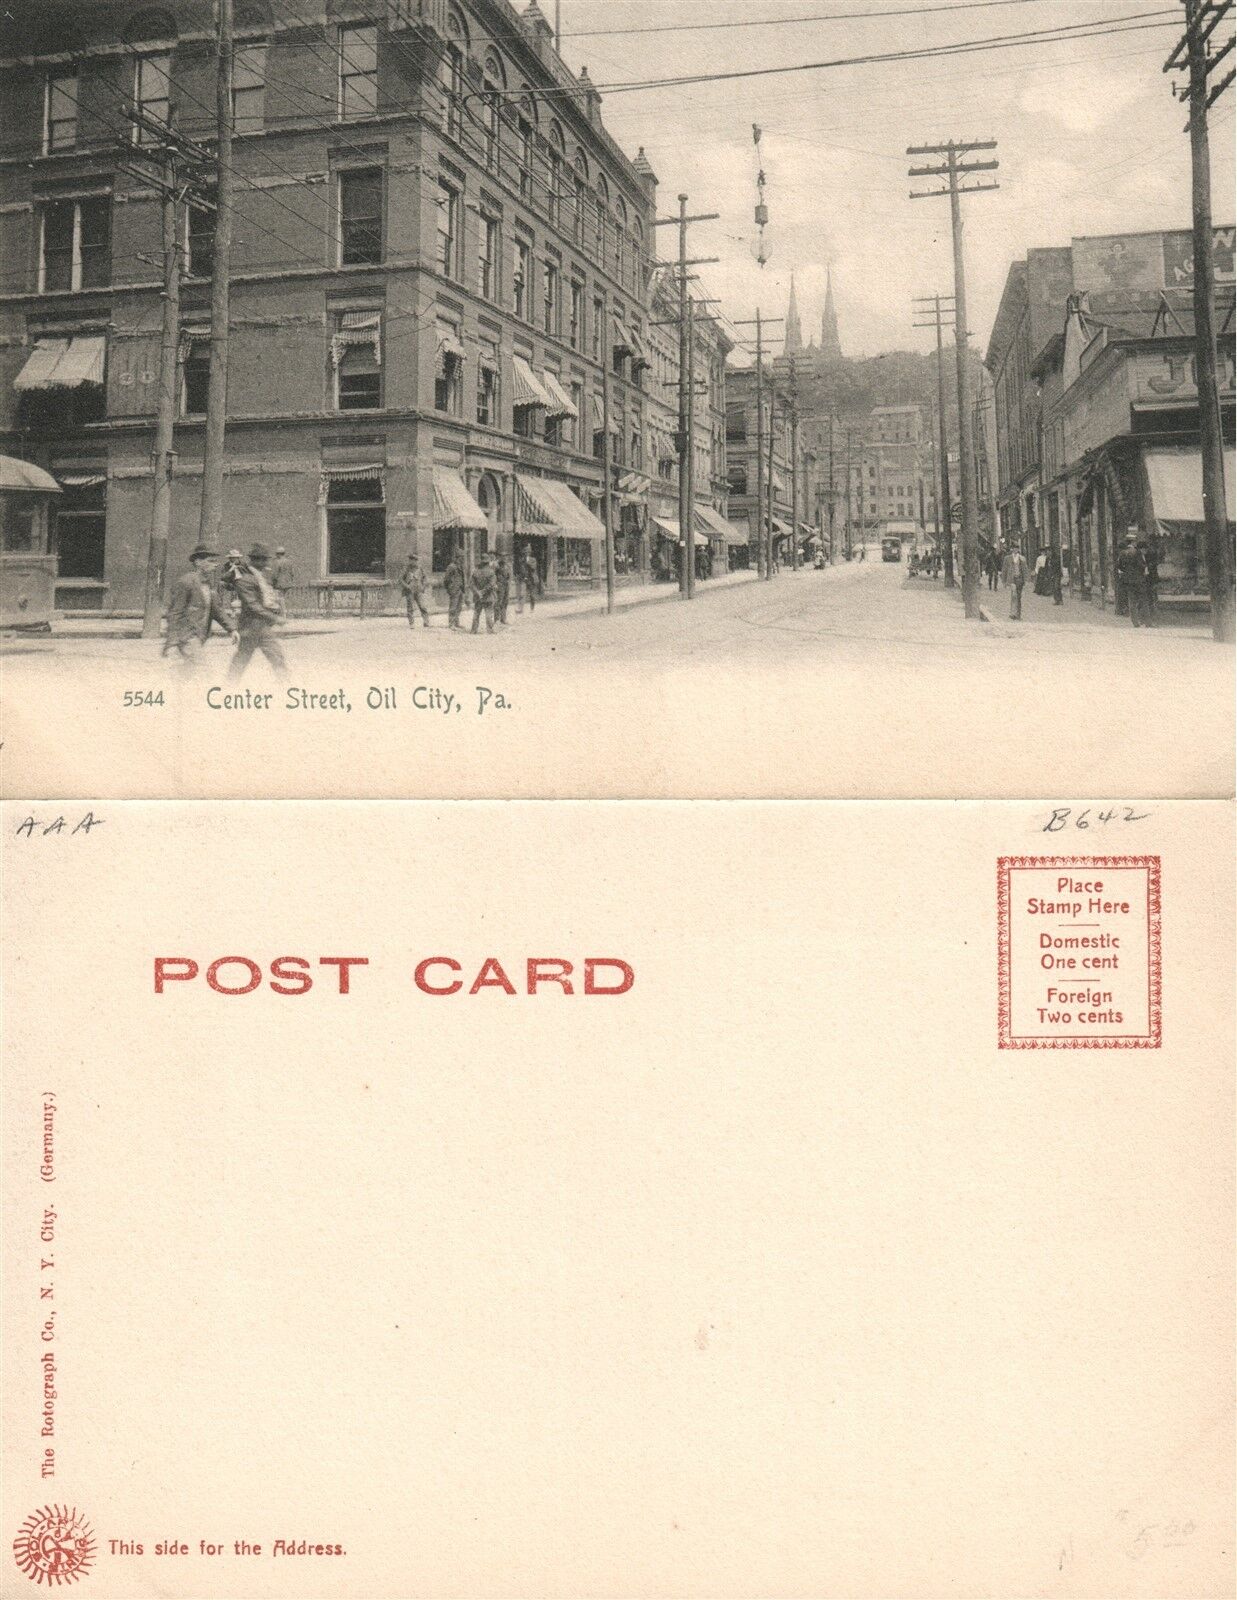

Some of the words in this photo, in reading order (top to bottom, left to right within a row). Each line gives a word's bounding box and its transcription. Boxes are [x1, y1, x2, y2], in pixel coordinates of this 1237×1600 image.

[1057, 877, 1104, 894] Place
[1026, 897, 1083, 918] Stamp
[1088, 897, 1130, 914] Here
[1039, 932, 1121, 949] Domestic
[1040, 953, 1077, 970] One
[1081, 953, 1120, 970] cent
[154, 956, 369, 996] POST
[413, 956, 636, 996] CARD
[1046, 987, 1113, 1008] Foreign
[1036, 1007, 1072, 1024] Two
[1077, 1007, 1124, 1024] cents
[40, 1091, 58, 1183] (Germany.)
[40, 1203, 58, 1243] City.
[40, 1253, 55, 1271] Y.
[40, 1283, 54, 1301] N.
[40, 1310, 57, 1343] Co.,
[41, 1352, 57, 1438] Rotograph
[41, 1447, 55, 1480] The
[108, 1539, 144, 1556] This
[154, 1539, 190, 1556] side
[199, 1539, 225, 1556] for
[234, 1539, 262, 1556] the
[272, 1539, 348, 1558] Address.
